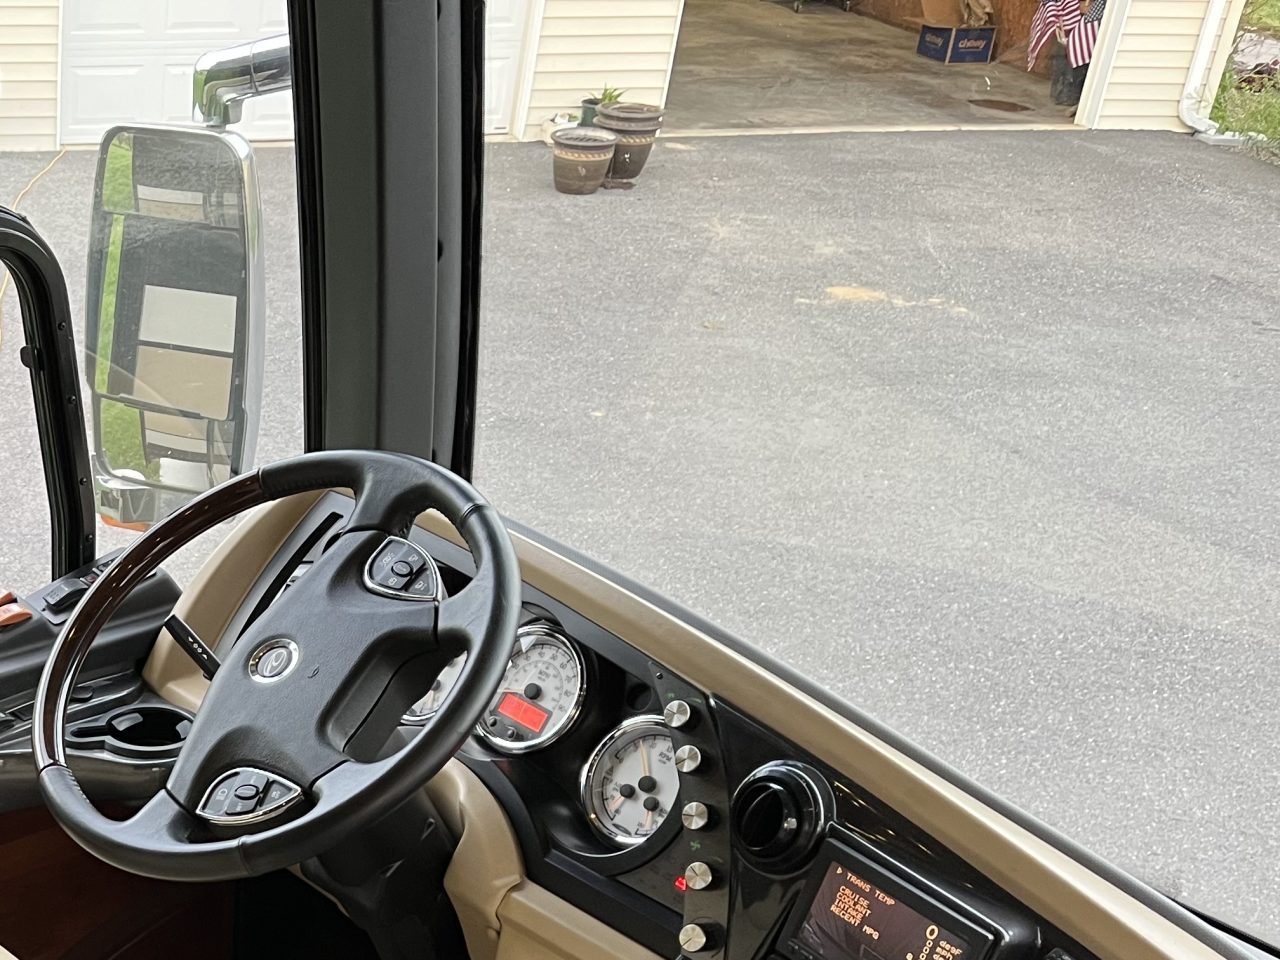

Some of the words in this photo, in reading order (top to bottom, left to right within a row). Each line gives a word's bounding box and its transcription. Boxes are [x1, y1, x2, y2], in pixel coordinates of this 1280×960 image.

[836, 892, 872, 917] COOLANT
[840, 885, 869, 909] CRUISE
[846, 873, 871, 893] TRANS
[875, 889, 896, 906] TEMP
[926, 925, 939, 940] 0
[830, 904, 860, 927] RECENT
[862, 925, 880, 940] MPG
[834, 899, 864, 921] INTAKE
